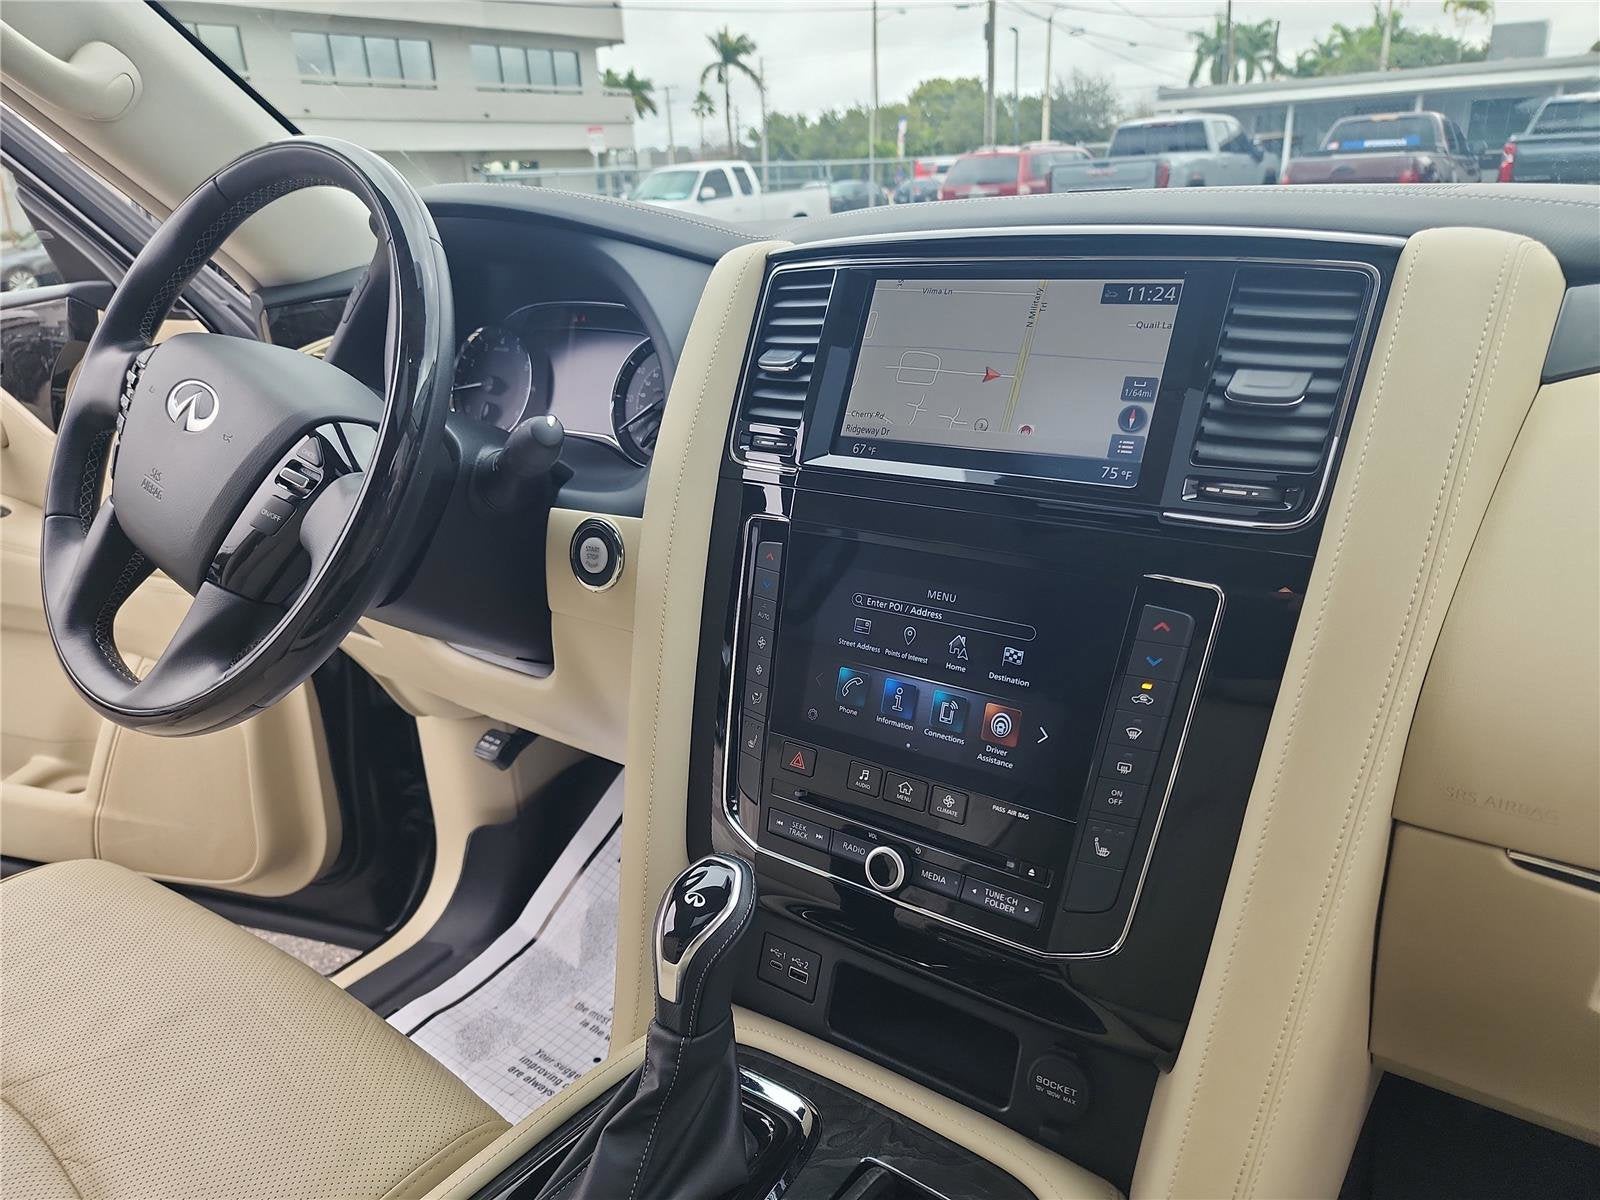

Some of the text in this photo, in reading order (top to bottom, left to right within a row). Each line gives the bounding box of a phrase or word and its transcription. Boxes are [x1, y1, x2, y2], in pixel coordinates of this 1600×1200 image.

[921, 287, 942, 295] Vilma
[1127, 286, 1176, 302] 11:24
[1028, 287, 1044, 320] Military
[1136, 321, 1160, 330] Quail
[1125, 388, 1152, 398] 1/64mi
[851, 410, 884, 420] Cherry Rd
[845, 424, 890, 437] Ridgeway Dr
[852, 443, 867, 454] 67
[1101, 466, 1119, 480] 75
[927, 589, 957, 603] MENU
[867, 597, 887, 609] Enter
[889, 602, 903, 612] POI
[909, 606, 943, 620] Address
[838, 637, 881, 653] Street Address
[884, 648, 901, 658] Points
[908, 654, 928, 664] Interest
[945, 662, 967, 673] Home
[988, 671, 1030, 687] Destination
[839, 705, 858, 716] Phone
[876, 715, 914, 731] Information
[923, 728, 965, 745] Connections
[985, 744, 1008, 757] Driver
[976, 753, 1014, 769] Assistance
[855, 781, 871, 790] AUDIO
[896, 793, 912, 803] MENU
[1111, 789, 1123, 797] ON
[1108, 797, 1124, 806] OFF
[936, 805, 959, 818] CLIMATE
[788, 827, 809, 840] TRACK
[791, 821, 808, 832] SEEK
[842, 841, 866, 856] RADIO
[920, 869, 946, 885] MEDIA
[984, 897, 1016, 914] FOLDER
[574, 1001, 611, 1025] the most
[579, 1019, 589, 1028] in
[589, 1024, 604, 1037] the
[535, 1048, 556, 1064] Your
[519, 1055, 563, 1087] improving
[507, 1065, 555, 1097] are always
[1035, 1075, 1078, 1097] SOCKET
